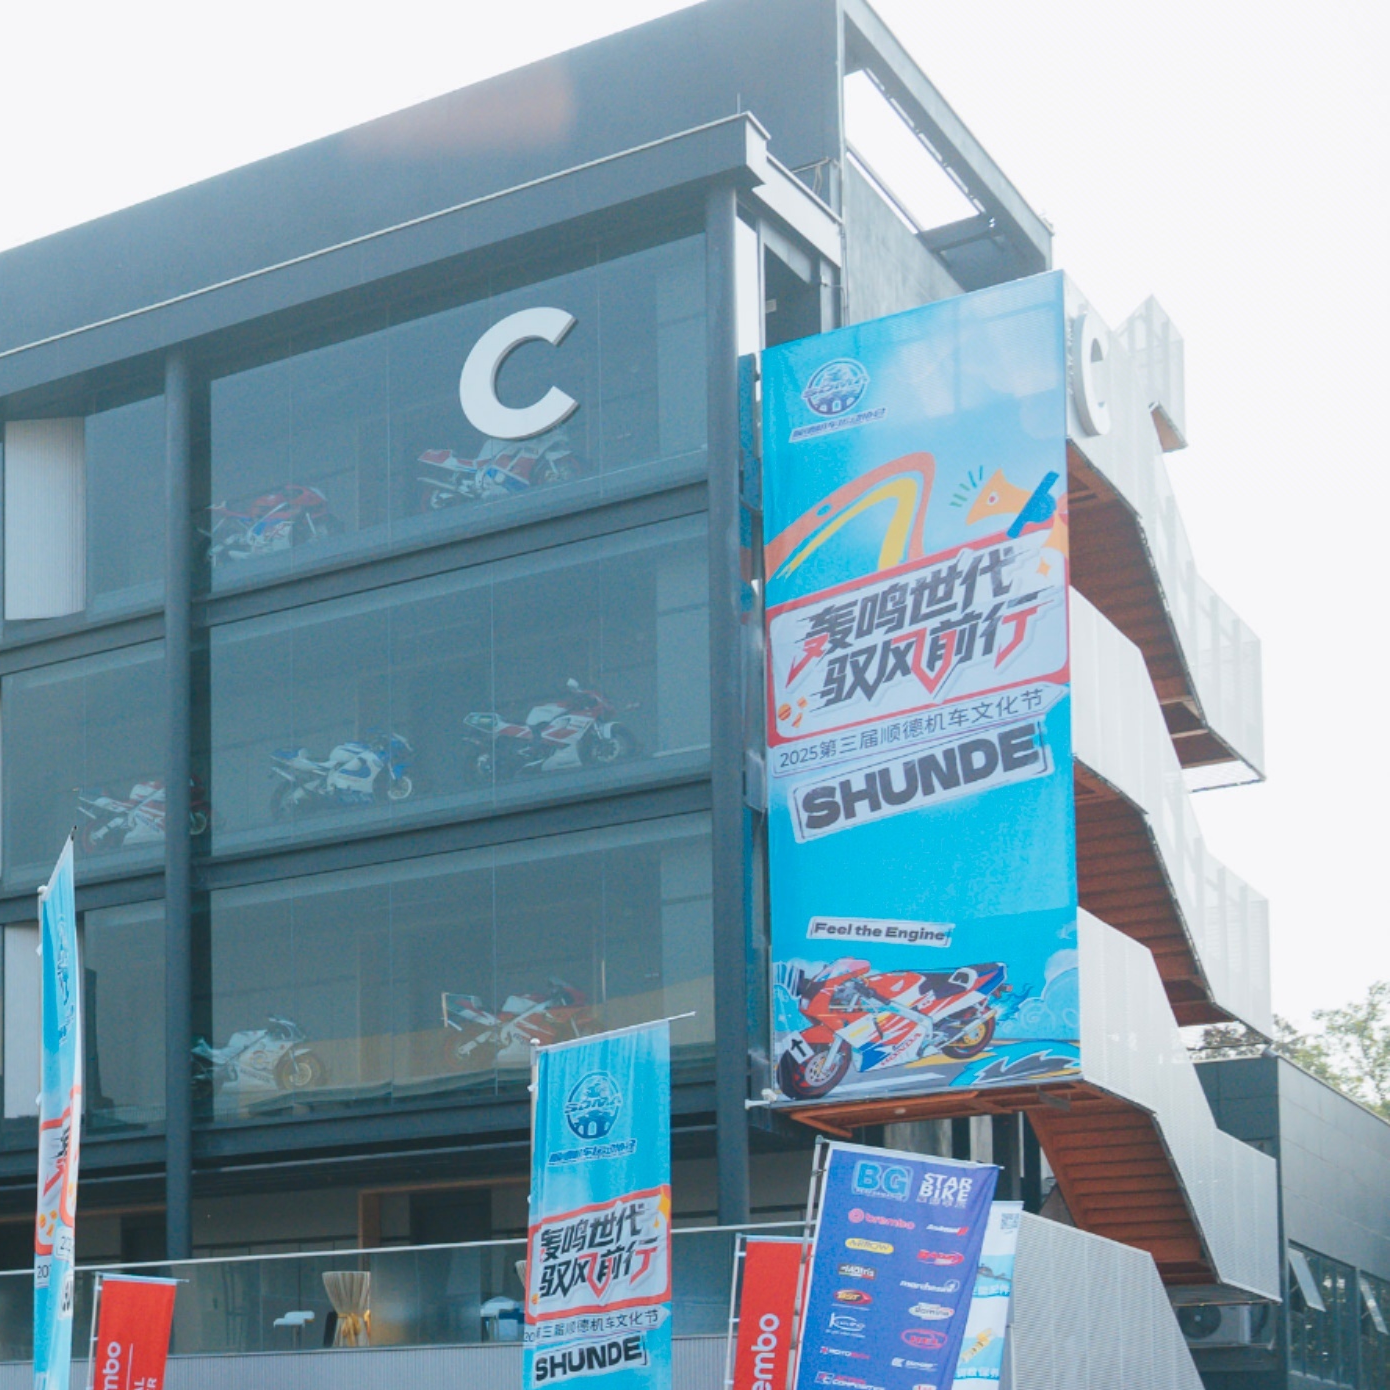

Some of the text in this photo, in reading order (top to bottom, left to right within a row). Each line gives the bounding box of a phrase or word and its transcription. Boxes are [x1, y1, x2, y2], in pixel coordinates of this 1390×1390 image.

[459, 306, 580, 440] C
[789, 546, 1016, 672] 轰鸣世代
[813, 588, 1043, 704] 驭风前行
[779, 687, 1044, 767] 2025第三届顺德机车文化节
[801, 723, 1041, 830] SHUNDE
[813, 921, 947, 942] Feel the Engine
[856, 1162, 909, 1196] BG
[919, 1181, 969, 1202] BIKE
[924, 1172, 973, 1190] STAR
[539, 1203, 645, 1262] 轰鸣世代
[539, 1238, 659, 1299] 驭风前行
[535, 1336, 643, 1382] SHUNDE
